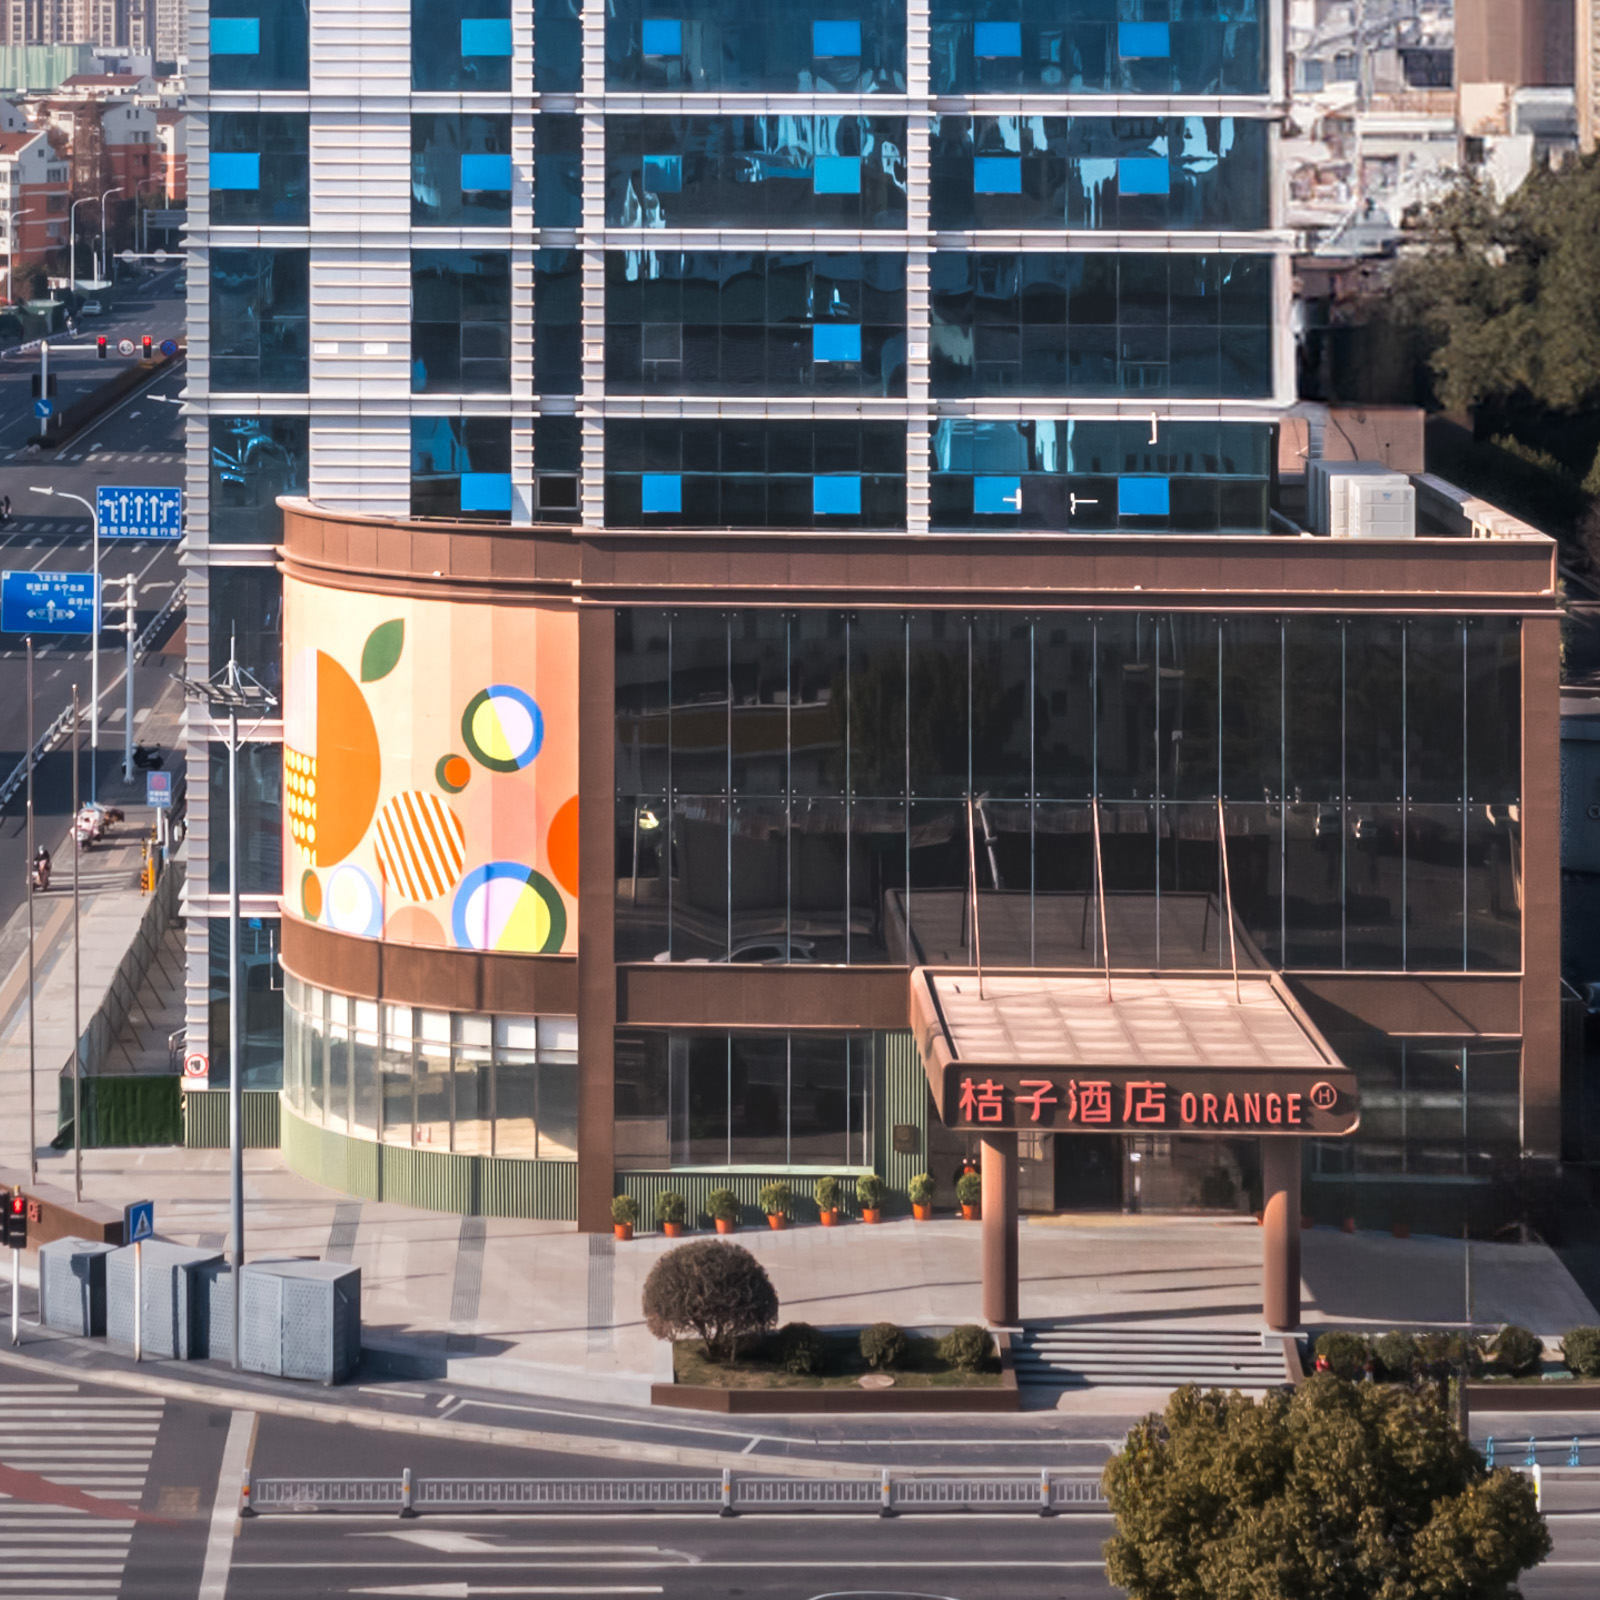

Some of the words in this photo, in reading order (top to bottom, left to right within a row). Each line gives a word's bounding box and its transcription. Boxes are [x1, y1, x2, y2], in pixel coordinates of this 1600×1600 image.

[959, 1078, 1167, 1123] 桔子酒店
[1180, 1092, 1302, 1124] ORANGE
